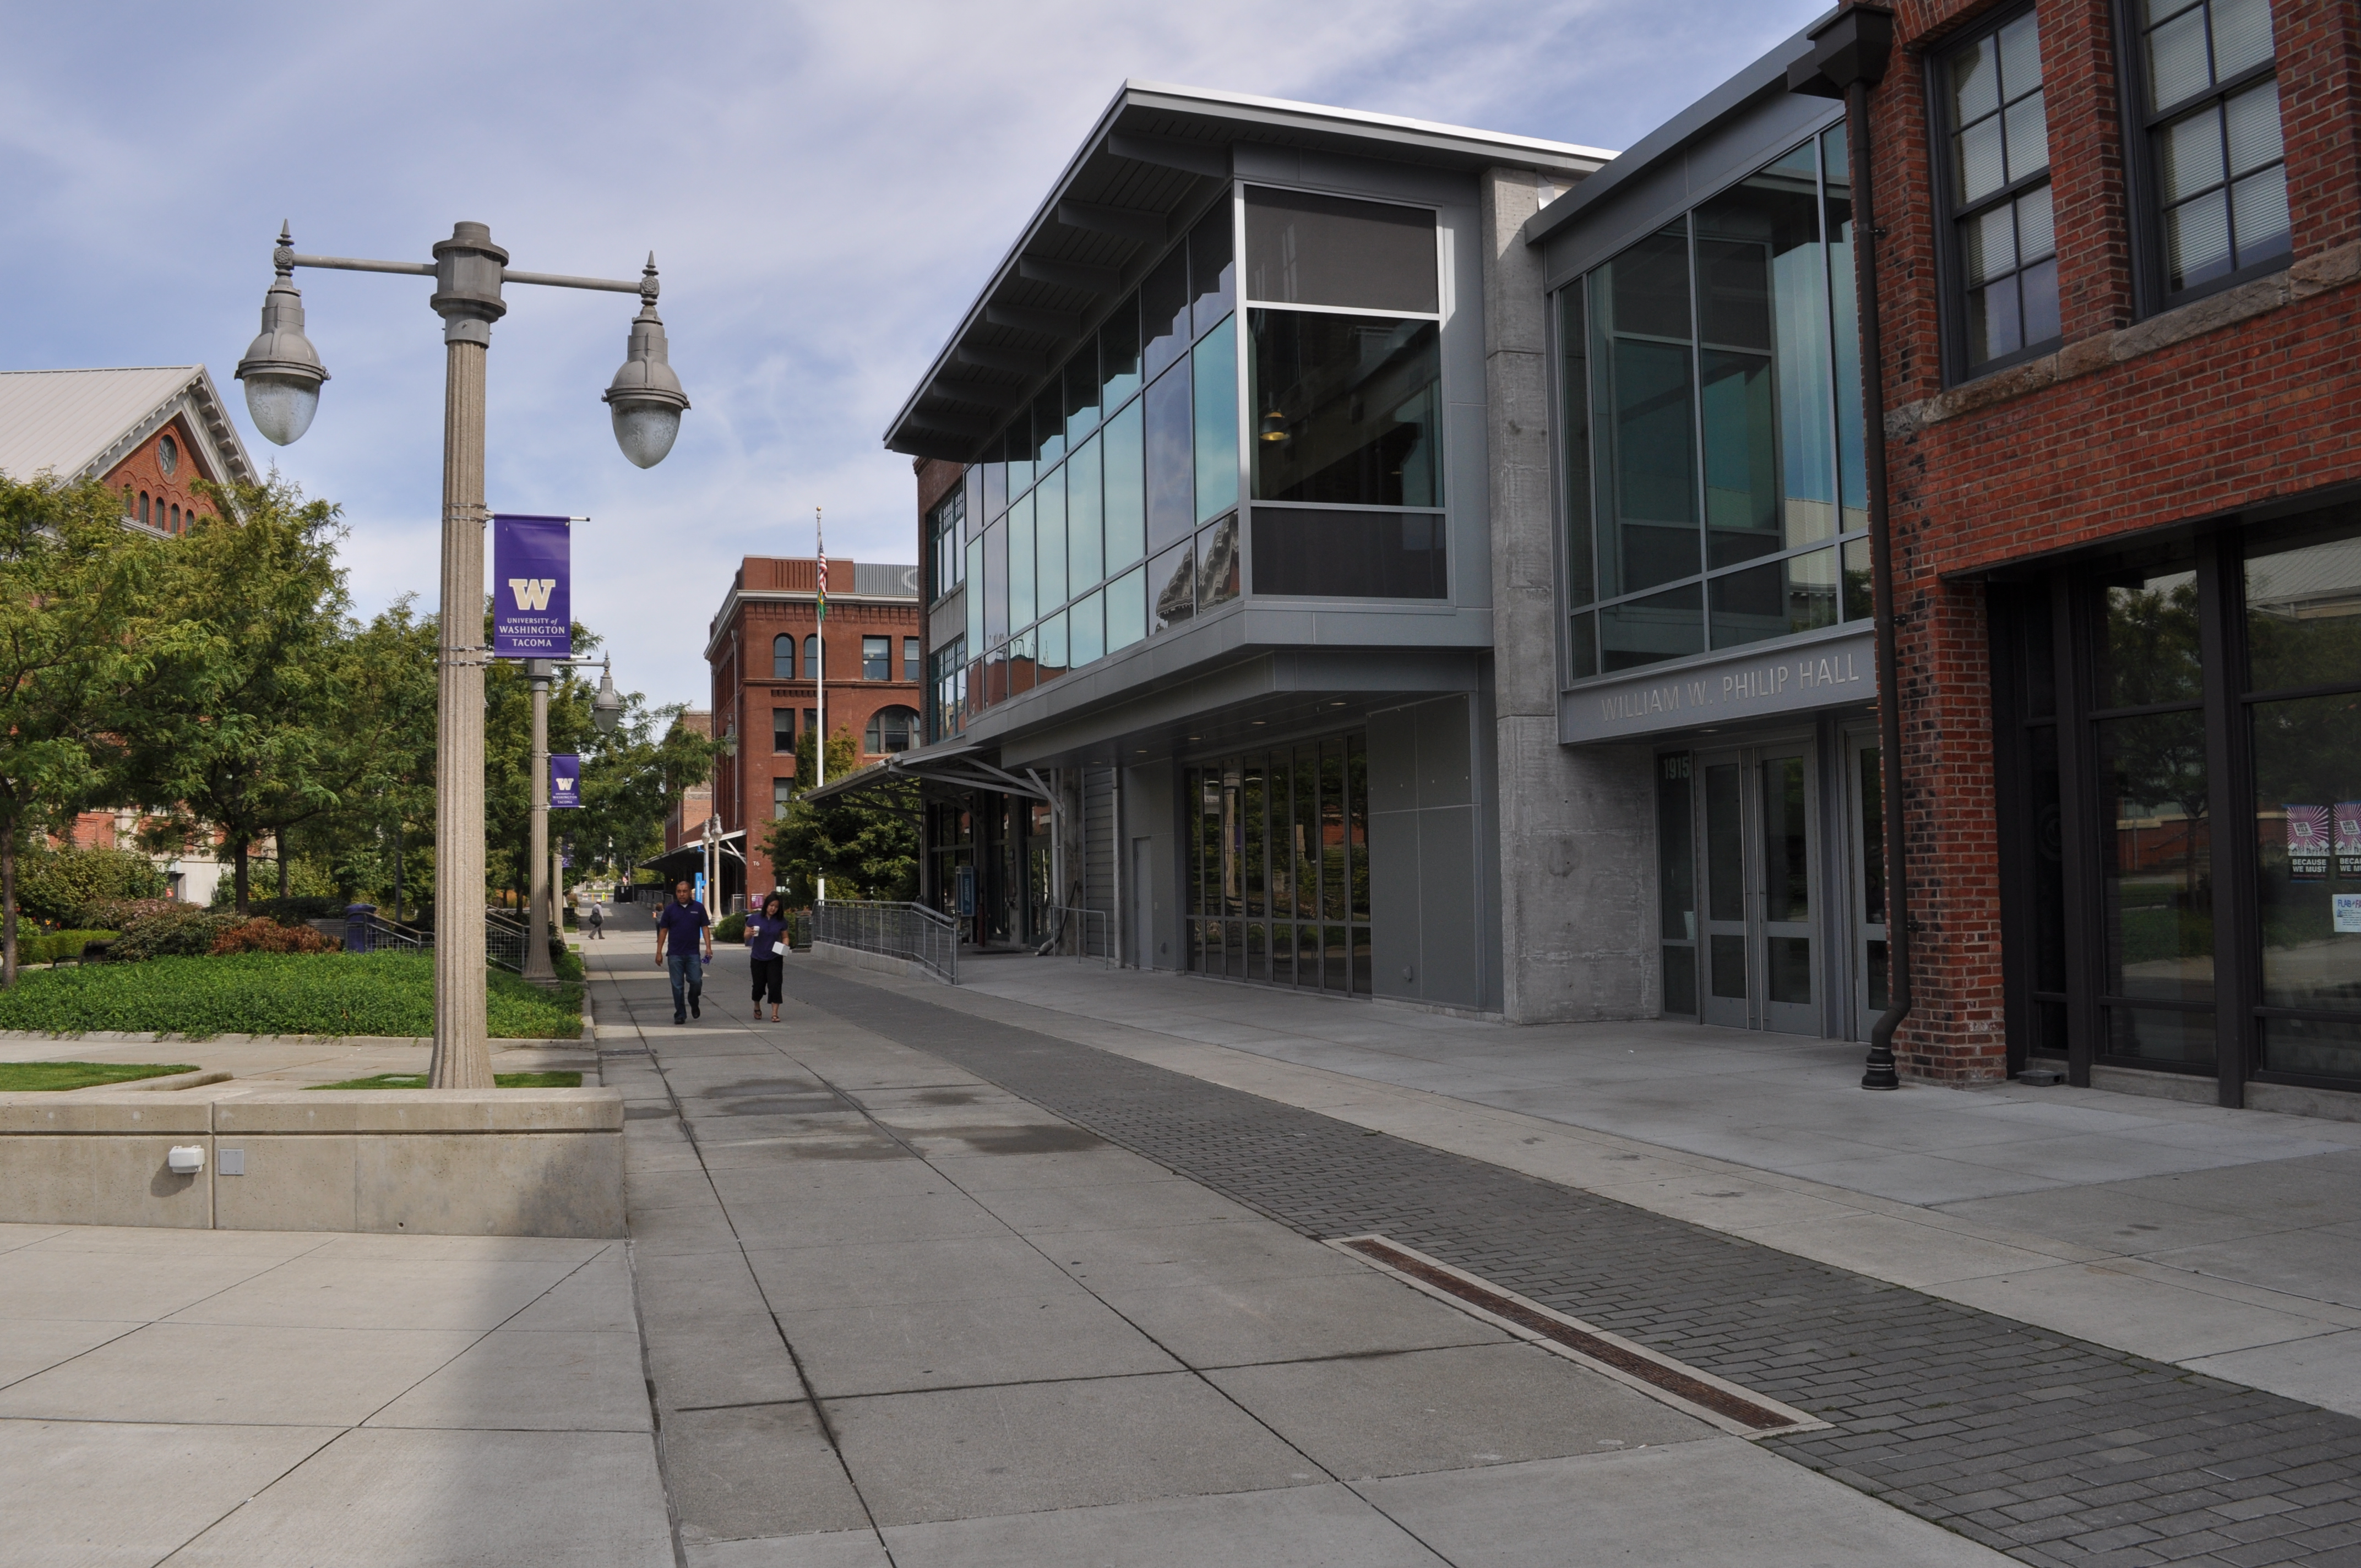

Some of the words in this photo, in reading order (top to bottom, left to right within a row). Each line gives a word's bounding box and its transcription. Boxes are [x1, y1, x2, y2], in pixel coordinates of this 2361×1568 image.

[509, 579, 556, 610] W
[499, 626, 565, 634] WASHINGTON
[512, 639, 552, 647] TACOMA
[1602, 686, 1679, 722] WILLIAM
[1688, 681, 1713, 707] W.
[1723, 666, 1788, 702] PHILIP
[1799, 654, 1859, 689] HALL
[1663, 756, 1689, 780] 1915
[556, 778, 574, 790] W
